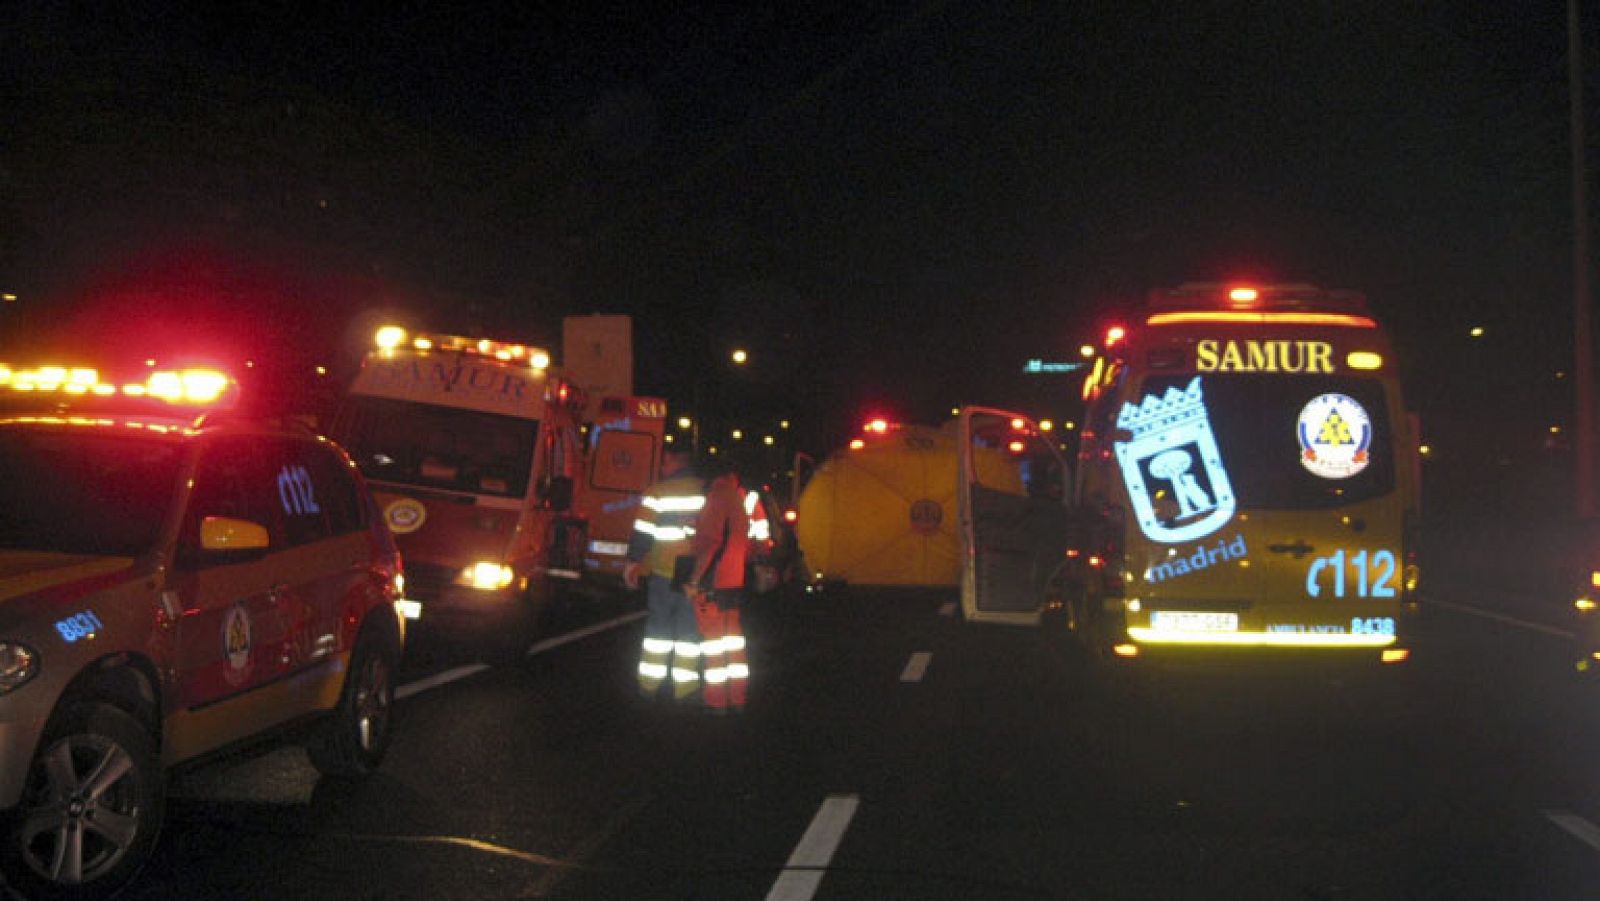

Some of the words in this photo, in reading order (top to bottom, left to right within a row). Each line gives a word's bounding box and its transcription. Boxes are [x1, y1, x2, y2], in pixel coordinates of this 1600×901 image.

[1197, 339, 1335, 373] SAMUR
[1144, 534, 1247, 583] madrid
[1328, 548, 1395, 598] 112
[55, 610, 103, 642] 8831
[1351, 617, 1394, 635] 8438
